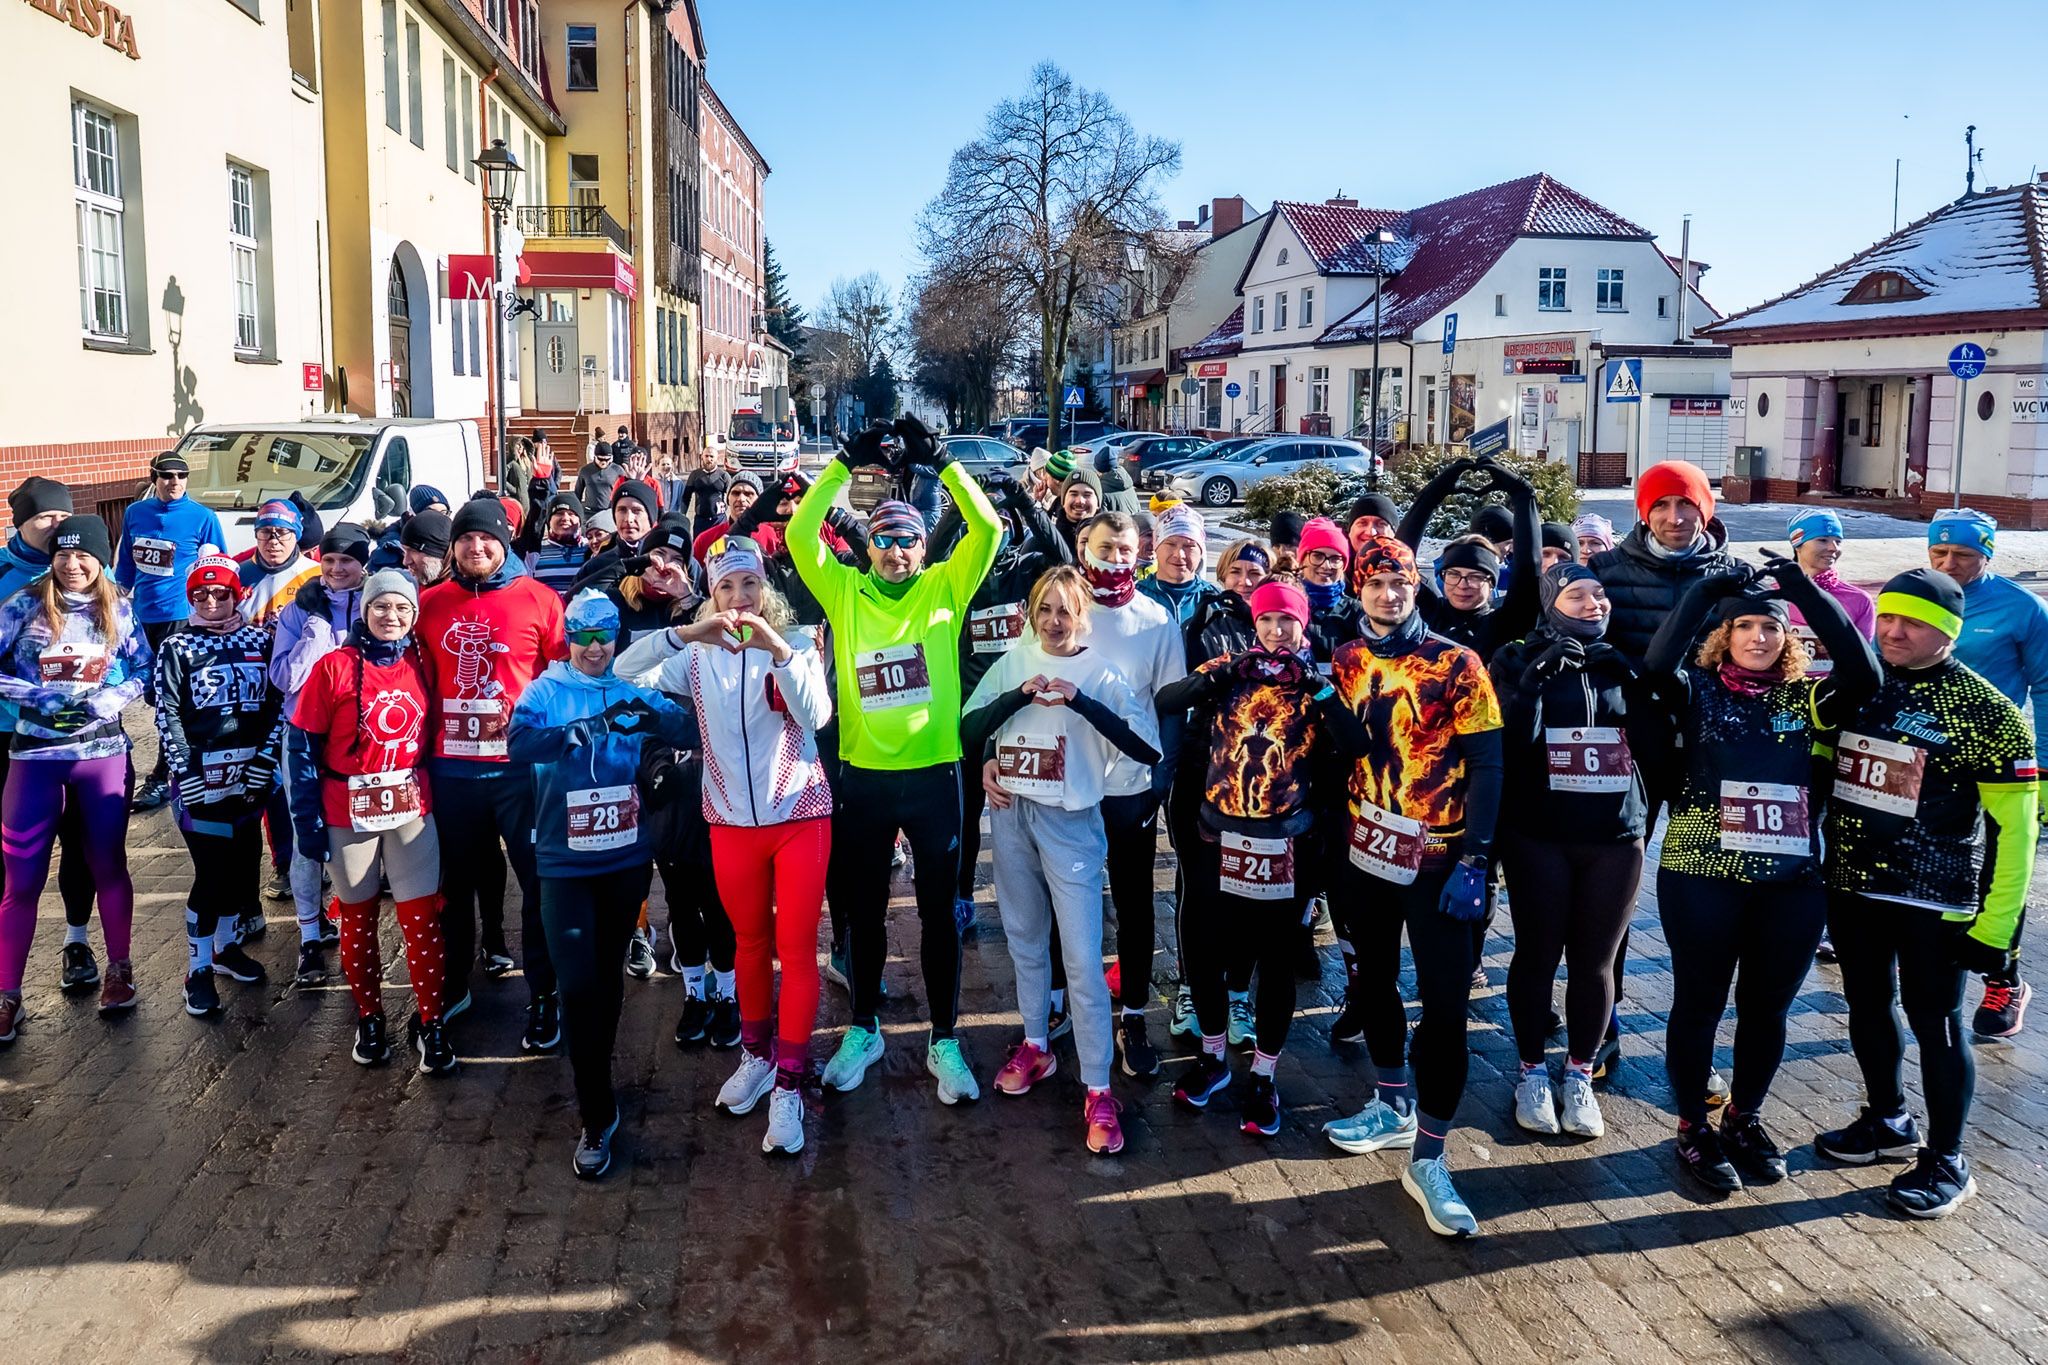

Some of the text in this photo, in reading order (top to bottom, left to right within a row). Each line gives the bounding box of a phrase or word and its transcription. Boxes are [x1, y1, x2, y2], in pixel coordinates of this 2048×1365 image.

[1445, 317, 1455, 341] P
[1730, 400, 1745, 409] WC
[2013, 401, 2037, 413] WC
[144, 549, 161, 564] 28
[989, 619, 1009, 638] 14
[72, 658, 87, 679] 2
[880, 664, 906, 689] 10
[467, 716, 480, 738] 9
[1018, 751, 1040, 775] 21
[1584, 747, 1600, 772] 6
[225, 763, 245, 785] 25
[1859, 757, 1888, 787] 18
[380, 789, 394, 812] 9
[593, 805, 619, 831] 28
[1752, 803, 1783, 831] 18
[1368, 828, 1398, 859] 24
[1244, 856, 1272, 881] 24
